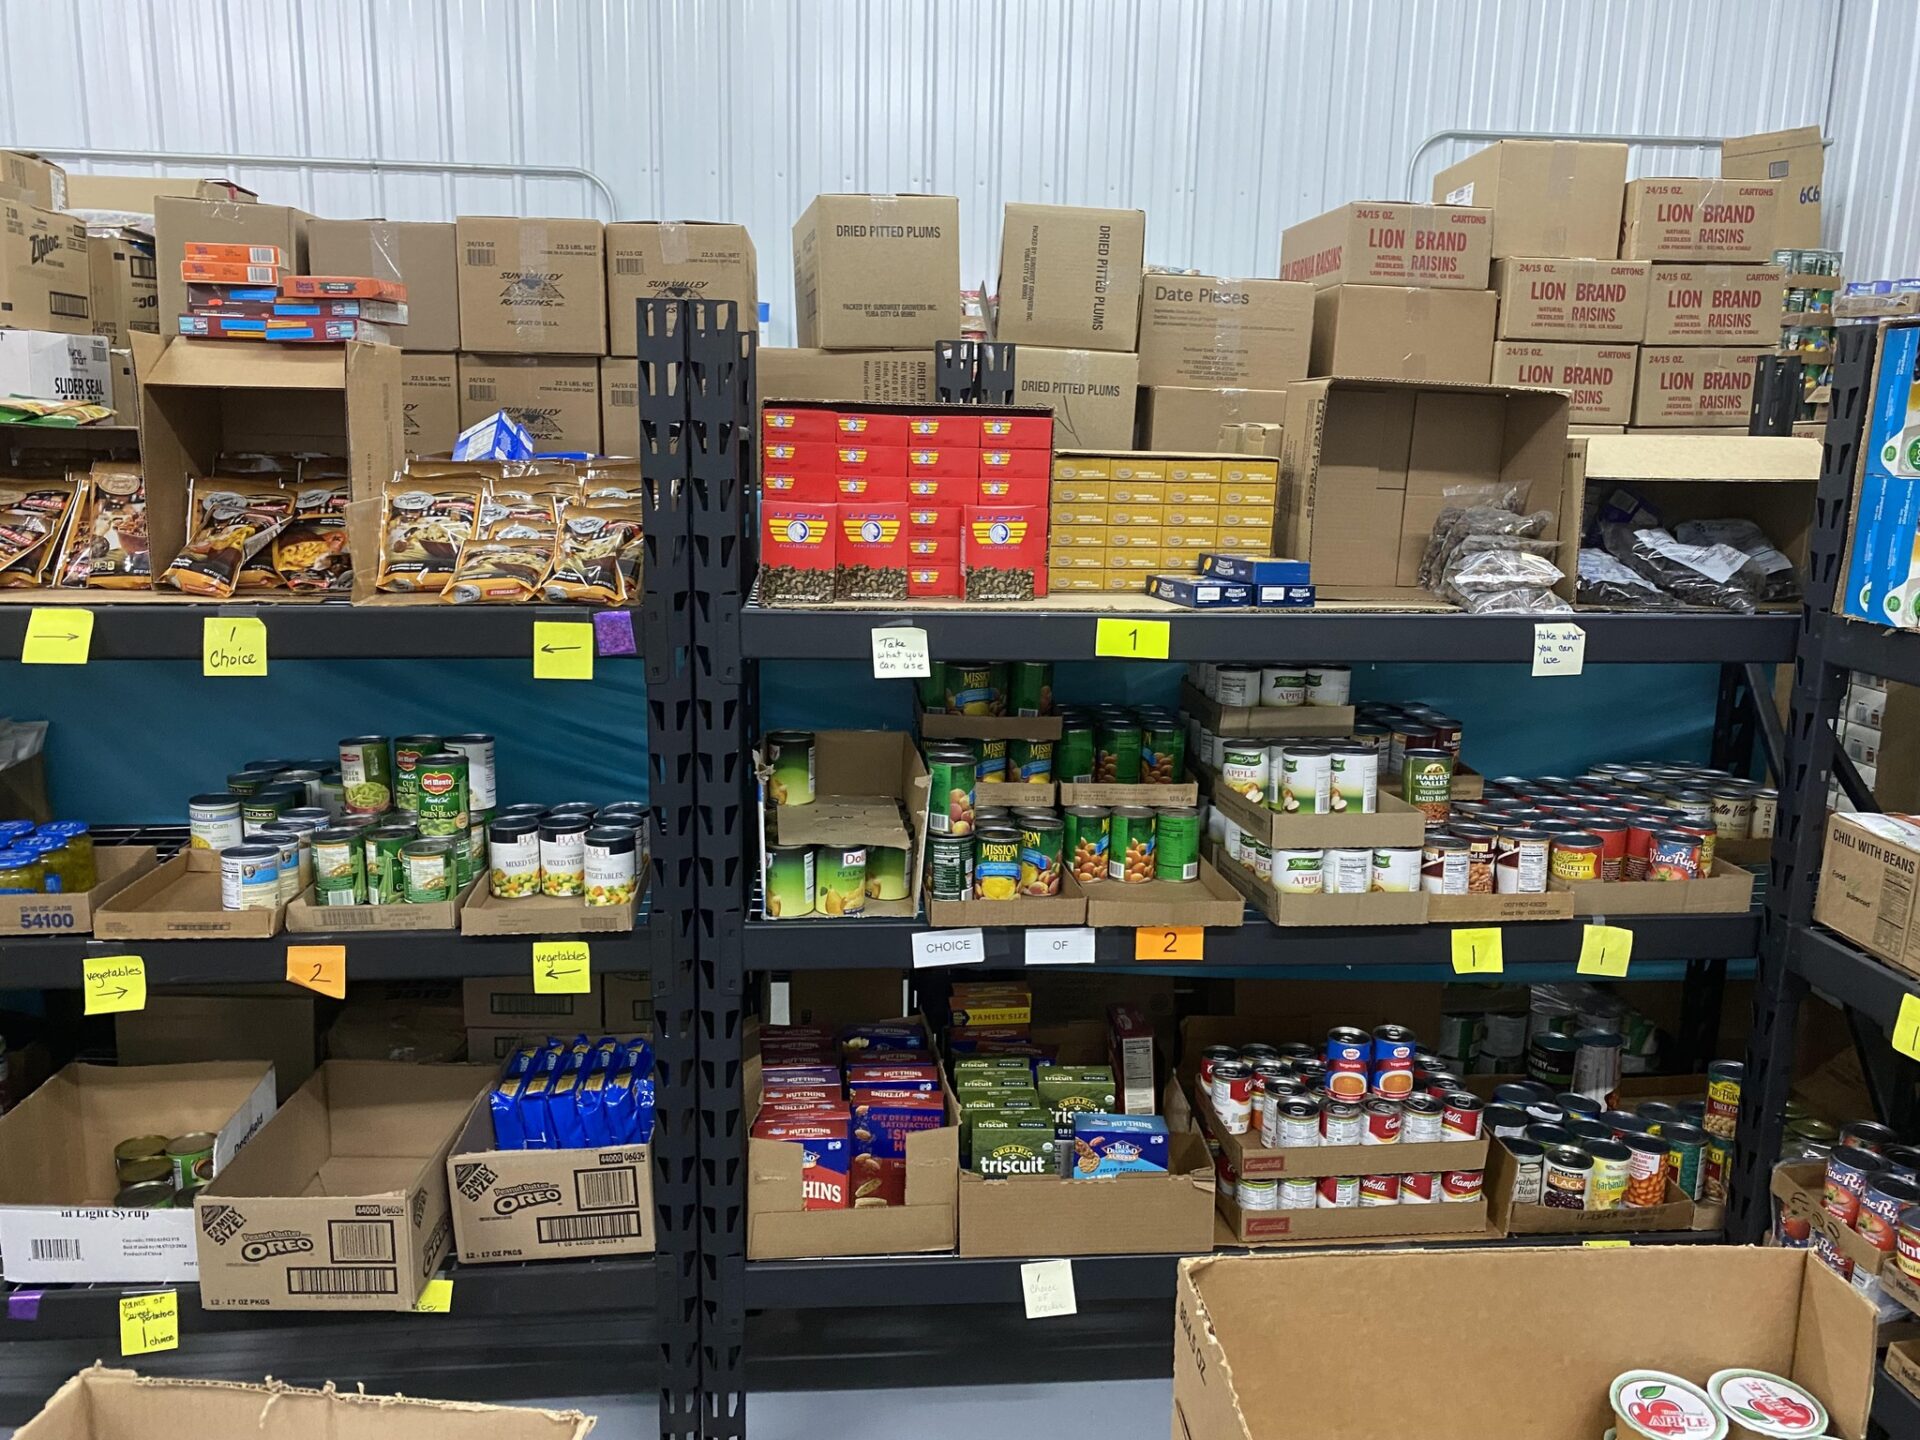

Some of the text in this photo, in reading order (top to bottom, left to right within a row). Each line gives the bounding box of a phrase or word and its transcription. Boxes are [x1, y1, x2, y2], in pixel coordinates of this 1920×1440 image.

[1739, 188, 1773, 196] CARTONS
[1800, 186, 1820, 204] 6C6
[1356, 210, 1379, 218] 24/15
[1452, 214, 1486, 224] CARTONS
[1658, 204, 1755, 223] LION BRAND
[836, 225, 940, 238] DRIED PITTED PLUMS
[1700, 229, 1744, 244] RAISINS
[1369, 228, 1466, 251] LION BRAND
[1316, 245, 1342, 276] RAISINS
[1411, 255, 1456, 272] RAISINS
[1520, 264, 1541, 272] 24/15
[1610, 268, 1644, 276] CARTONS
[500, 272, 520, 280] SUN
[1092, 226, 1110, 330] DRIED PITTED PLUMS
[1156, 286, 1250, 305] Date Pieces
[1531, 282, 1627, 302] LION BRAND
[1668, 290, 1762, 308] LION BRAND
[1572, 307, 1616, 322] RAISINS
[1708, 314, 1752, 328] RAISINS
[1506, 348, 1529, 356] 24/15
[1598, 351, 1631, 360] CARTONS
[1650, 356, 1670, 364] 24/15
[918, 362, 926, 388] DRIED
[1519, 365, 1613, 384] LION BRAND
[1660, 372, 1752, 390] LION BRAND
[55, 378, 104, 396] SLIDER SEAL
[1022, 380, 1120, 397] DRIED PITTED PLUMS
[1700, 394, 1742, 409] RAISINS
[774, 511, 824, 520] LION
[848, 511, 896, 520] LION
[879, 638, 906, 648] Take
[1129, 629, 1138, 650] 1
[1537, 630, 1583, 642] take what
[210, 648, 257, 666] Choice
[905, 652, 924, 661] you
[1538, 644, 1552, 656] you
[880, 662, 896, 670] can
[1543, 656, 1560, 664] use
[1225, 768, 1256, 778] APPLE
[420, 810, 438, 818] GREEN
[431, 804, 444, 812] CUT
[982, 844, 1018, 858] MISSION
[989, 854, 1012, 862] PRIDE
[1650, 848, 1672, 864] Vine
[1832, 828, 1915, 874] CHILI WITH BEANS
[506, 859, 527, 868] MIXED
[546, 858, 566, 866] MIXED
[1556, 868, 1581, 878] SAUCE
[20, 913, 74, 929] 54100
[926, 940, 972, 953] CHOICE
[1052, 940, 1068, 950] OF
[1163, 932, 1178, 953] 2
[536, 950, 586, 968] vegetables
[86, 966, 142, 988] vegetables
[309, 963, 332, 984] 2
[972, 1011, 1028, 1022] FAMILY SIZE
[1058, 1096, 1096, 1109] ORGANIC
[992, 1144, 1034, 1158] ORGANIC
[600, 1154, 622, 1164] 44000
[980, 1156, 1045, 1174] triscuit
[461, 1164, 489, 1196] FAMILY
[467, 1170, 498, 1202] SIZE!
[1550, 1174, 1584, 1190] BLACK
[494, 1184, 524, 1196] Peanut
[494, 1188, 562, 1215] OREO
[356, 1206, 380, 1215] 44000
[207, 1206, 238, 1239] FAMILY
[214, 1214, 248, 1246] SIZE!
[242, 1232, 274, 1242] Peanut
[242, 1238, 314, 1262] OREO
[1820, 1238, 1846, 1266] Ripe
[1747, 1382, 1805, 1418] APPLE
[1649, 1415, 1710, 1428] APPLE
